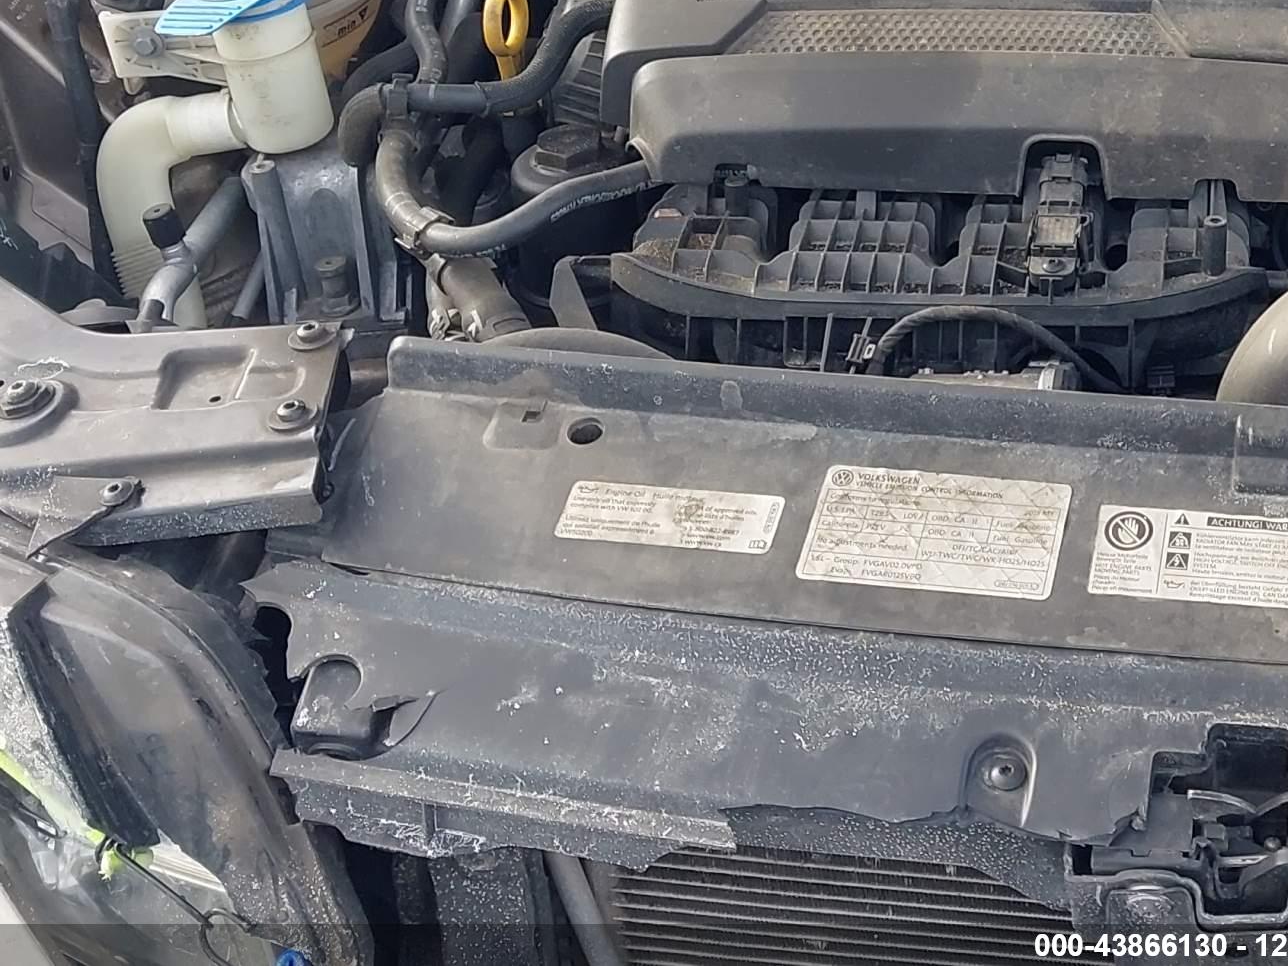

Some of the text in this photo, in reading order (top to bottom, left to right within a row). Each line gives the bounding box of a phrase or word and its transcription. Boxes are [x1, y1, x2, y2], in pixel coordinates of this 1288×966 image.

[337, 19, 356, 36] min
[856, 473, 920, 485] VOLKSWAGEN
[632, 490, 646, 498] Oil
[1210, 518, 1263, 529] ACHTUNG!
